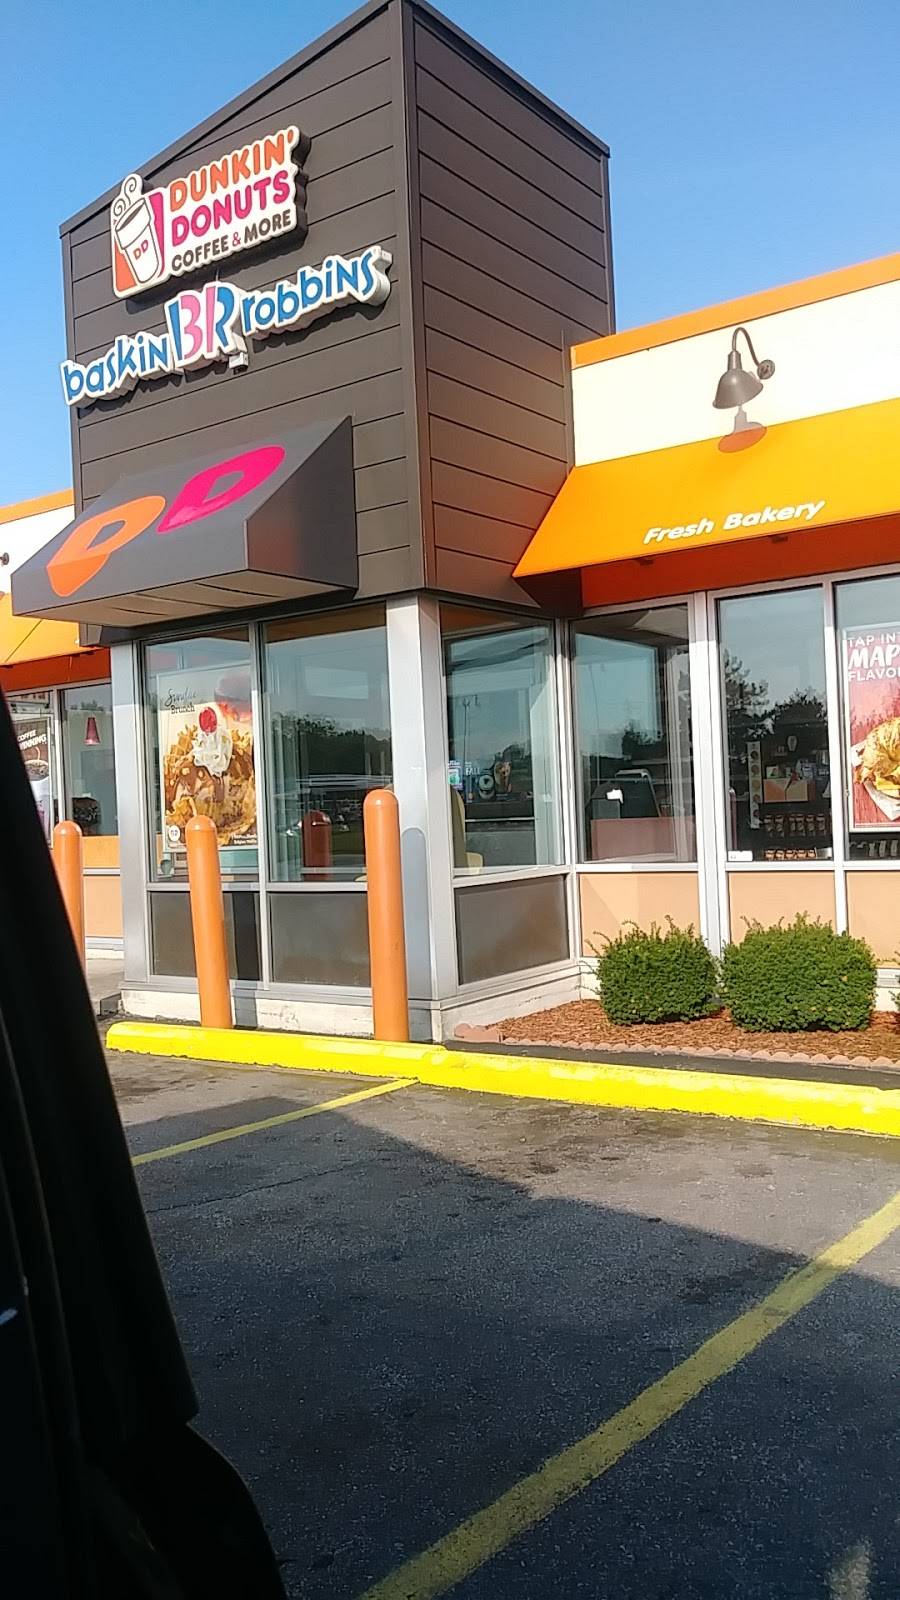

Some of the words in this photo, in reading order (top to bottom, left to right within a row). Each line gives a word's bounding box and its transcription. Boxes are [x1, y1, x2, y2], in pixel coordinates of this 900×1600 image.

[170, 129, 294, 212] DUNKIN'
[172, 170, 290, 247] DONUTS
[133, 239, 149, 260] DD
[171, 234, 229, 272] COFFEE
[232, 231, 241, 247] &
[244, 209, 291, 244] MORE
[63, 333, 169, 401] baskin
[167, 285, 235, 361] BR
[243, 251, 375, 334] robbins
[643, 518, 715, 544] Fresh
[723, 500, 825, 530] Bakery
[847, 635, 875, 648] TAP
[880, 631, 900, 644] IN
[848, 644, 900, 669] MAP
[848, 667, 900, 681] FLAVO
[171, 701, 195, 714] Brunch
